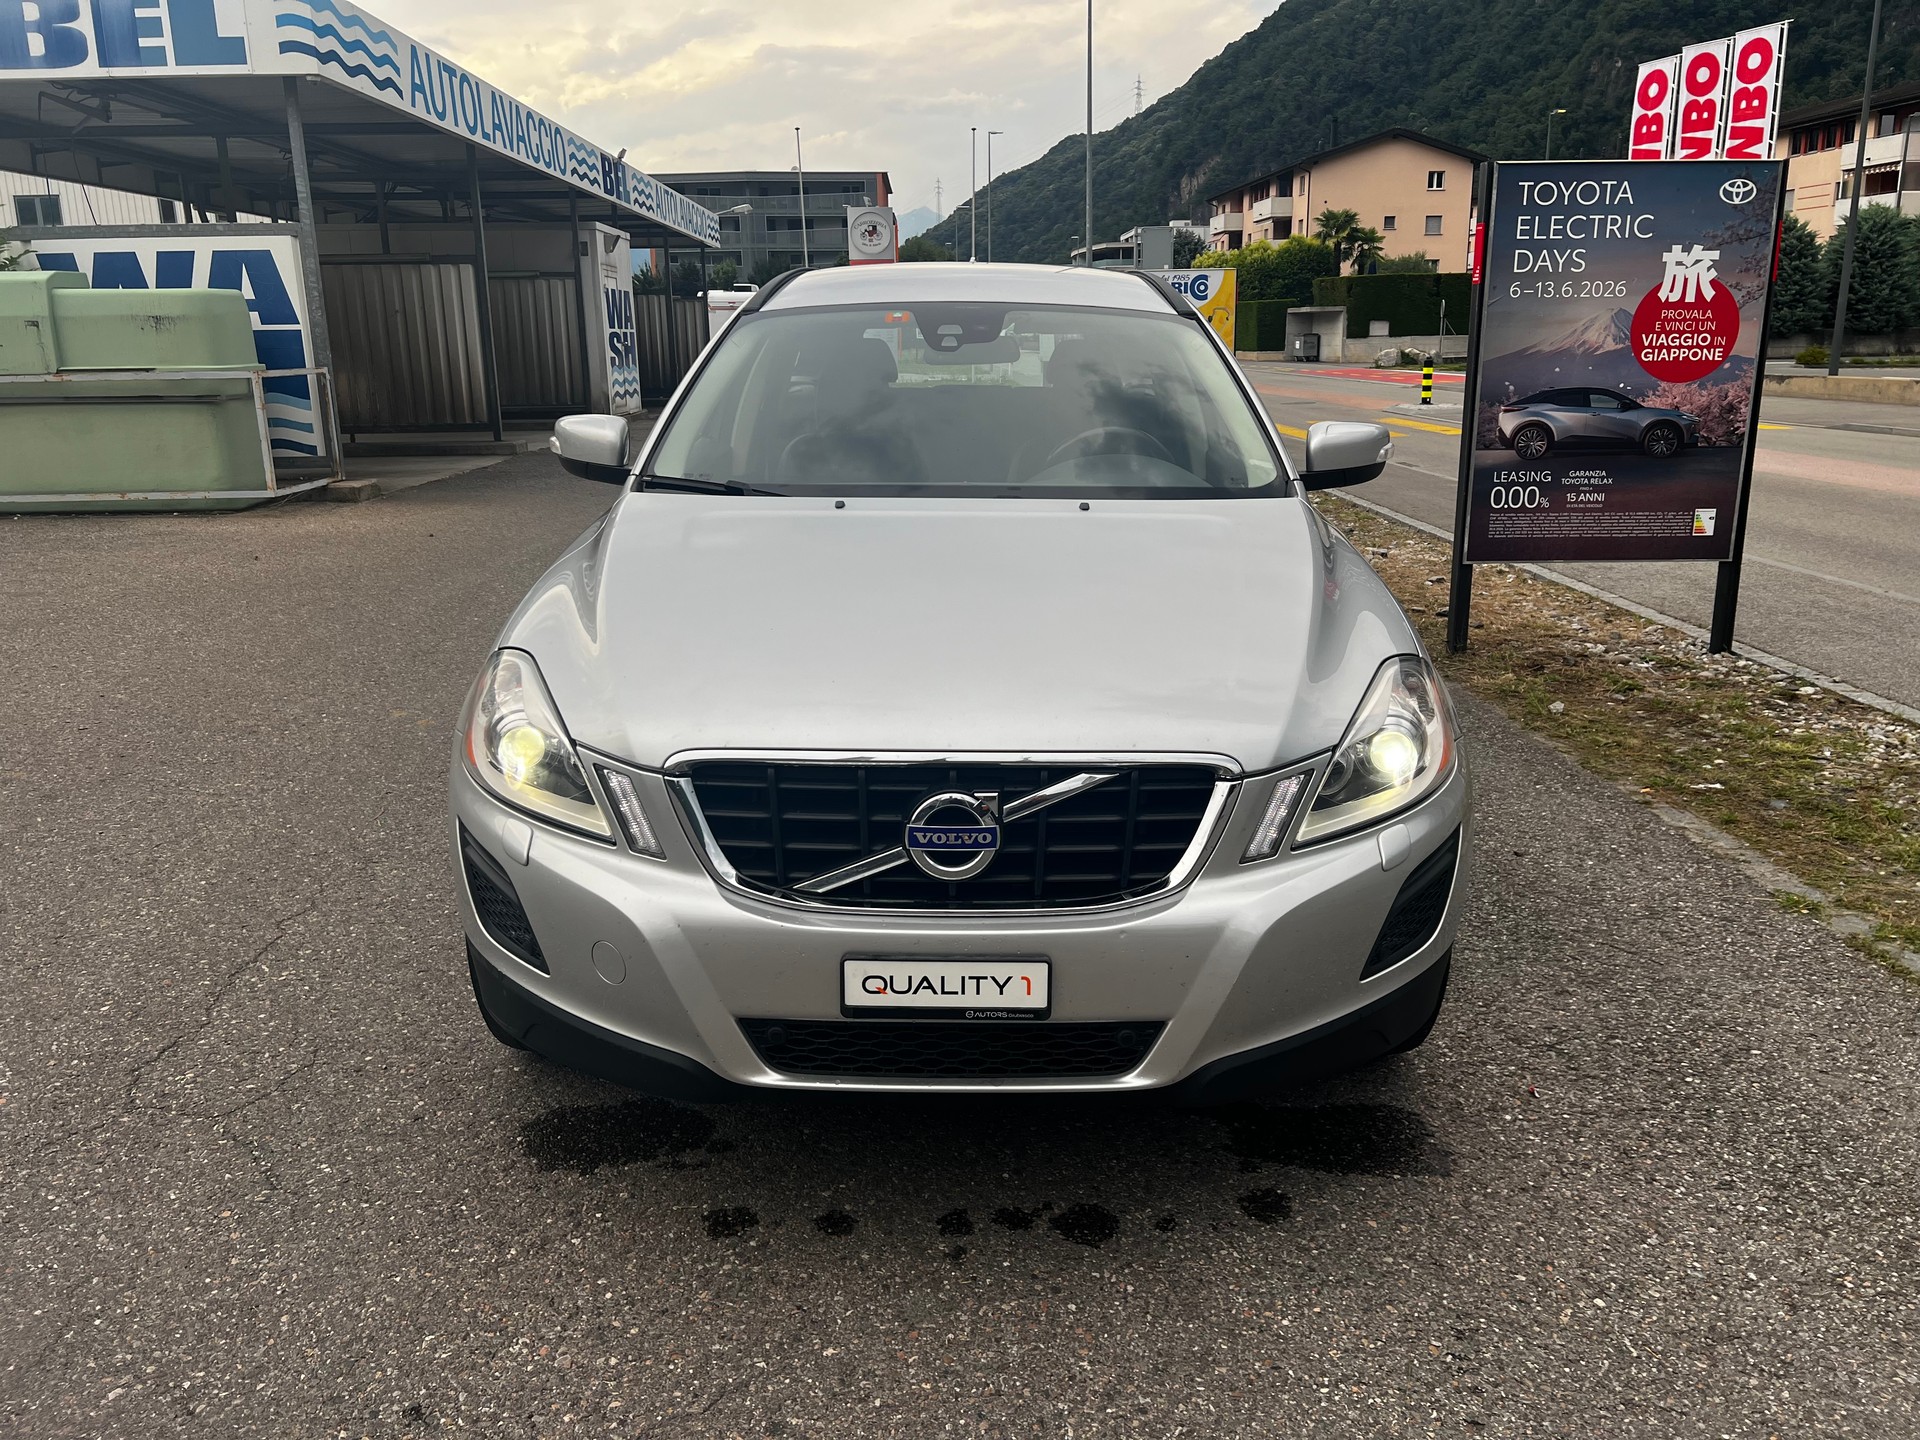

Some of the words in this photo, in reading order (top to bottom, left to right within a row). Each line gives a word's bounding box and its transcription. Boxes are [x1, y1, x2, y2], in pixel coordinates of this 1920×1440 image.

[0, 0, 248, 69] BEL
[600, 151, 631, 205] BEL
[1518, 181, 1634, 206] TOYOTA
[1515, 214, 1655, 240] ELECTRIC
[1513, 249, 1586, 273] DAYS
[1657, 244, 1721, 303] 旅
[606, 288, 635, 330] WA
[1661, 309, 1713, 319] PROVALA
[1655, 321, 1662, 331] E
[1664, 321, 1696, 331] VINCI
[1698, 321, 1716, 331] UN
[608, 331, 638, 369] SH
[1641, 333, 1711, 346] VIAGGIO
[1713, 336, 1726, 346] IN
[1641, 348, 1724, 361] GIAPPONE
[1493, 471, 1552, 482] LEASING
[1566, 493, 1577, 502] 15
[1577, 493, 1605, 502] ANNI
[914, 832, 992, 845] VOLVO
[861, 975, 1014, 995] QUALITY
[1021, 976, 1031, 996] 1
